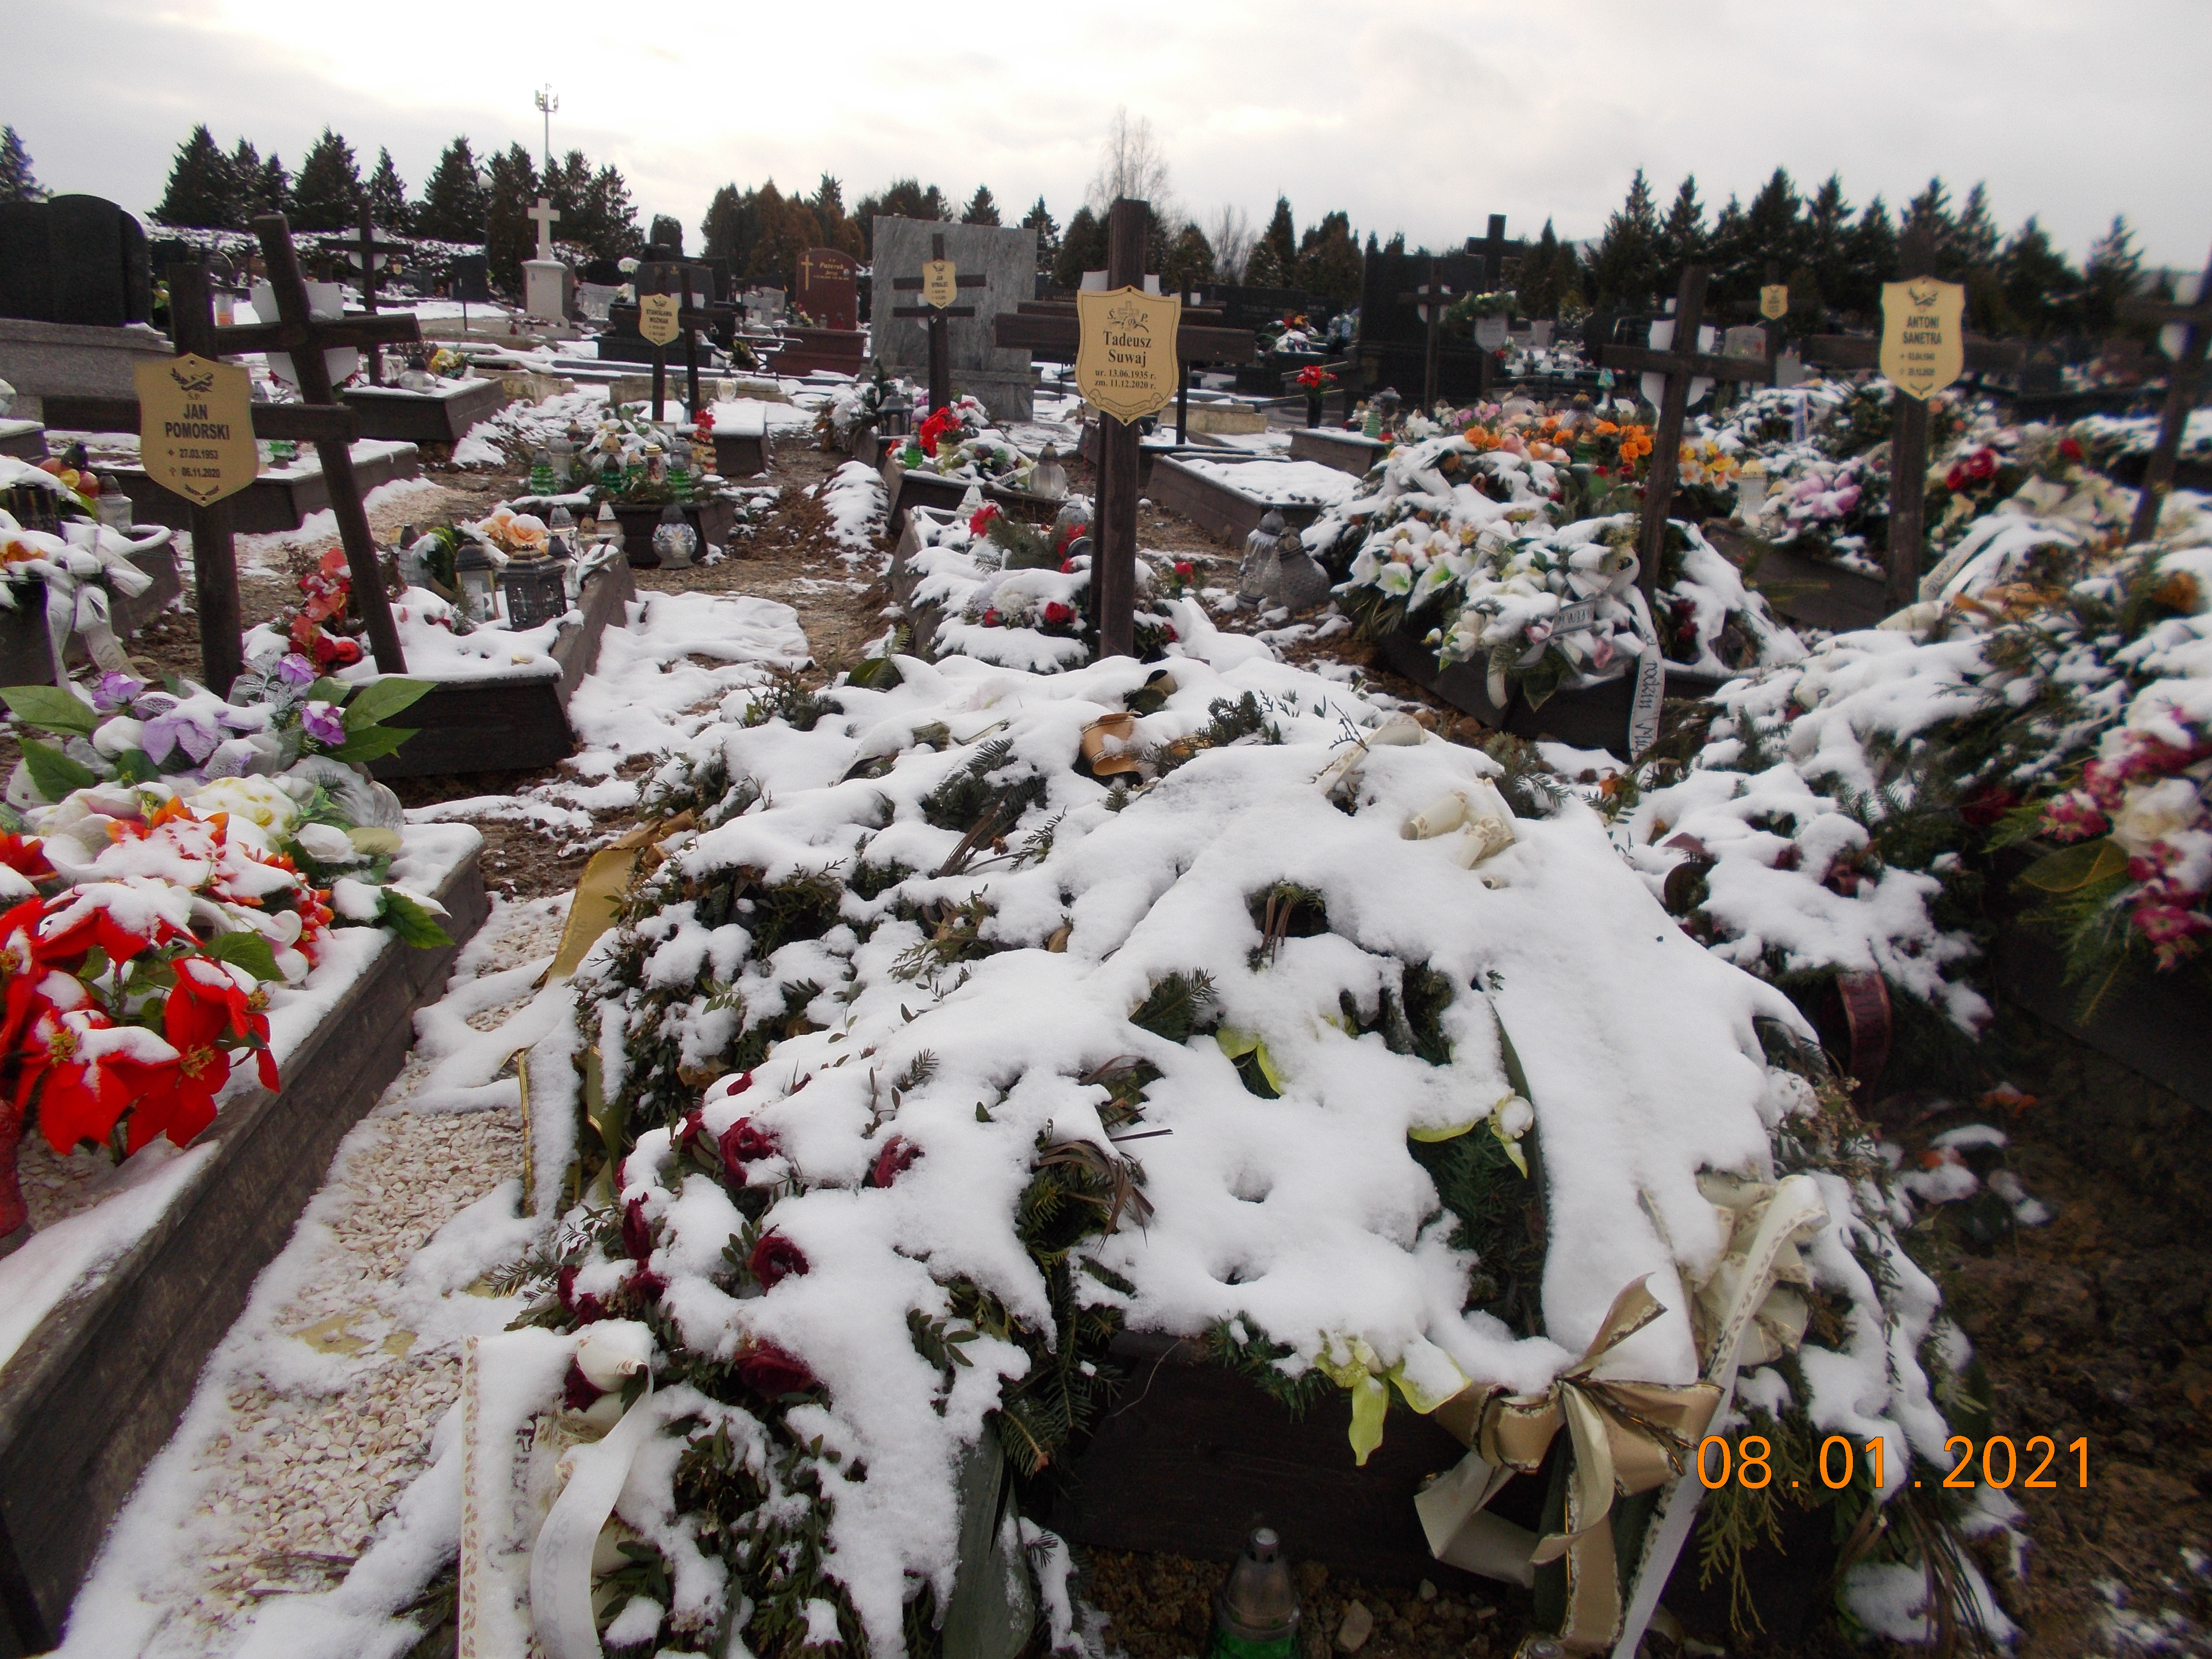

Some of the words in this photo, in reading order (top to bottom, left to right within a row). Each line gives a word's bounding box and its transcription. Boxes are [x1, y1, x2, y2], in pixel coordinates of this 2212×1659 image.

[1907, 315, 1940, 328] ANTONI
[1103, 331, 1152, 349] Tadeusz
[1903, 331, 1942, 344] SANETRA
[1108, 349, 1146, 368] Suwaj
[1109, 369, 1148, 379] 13.06.1935
[1110, 379, 1148, 389] 11.12.2020
[183, 404, 208, 420] JAN
[165, 422, 230, 440] POMORSKI
